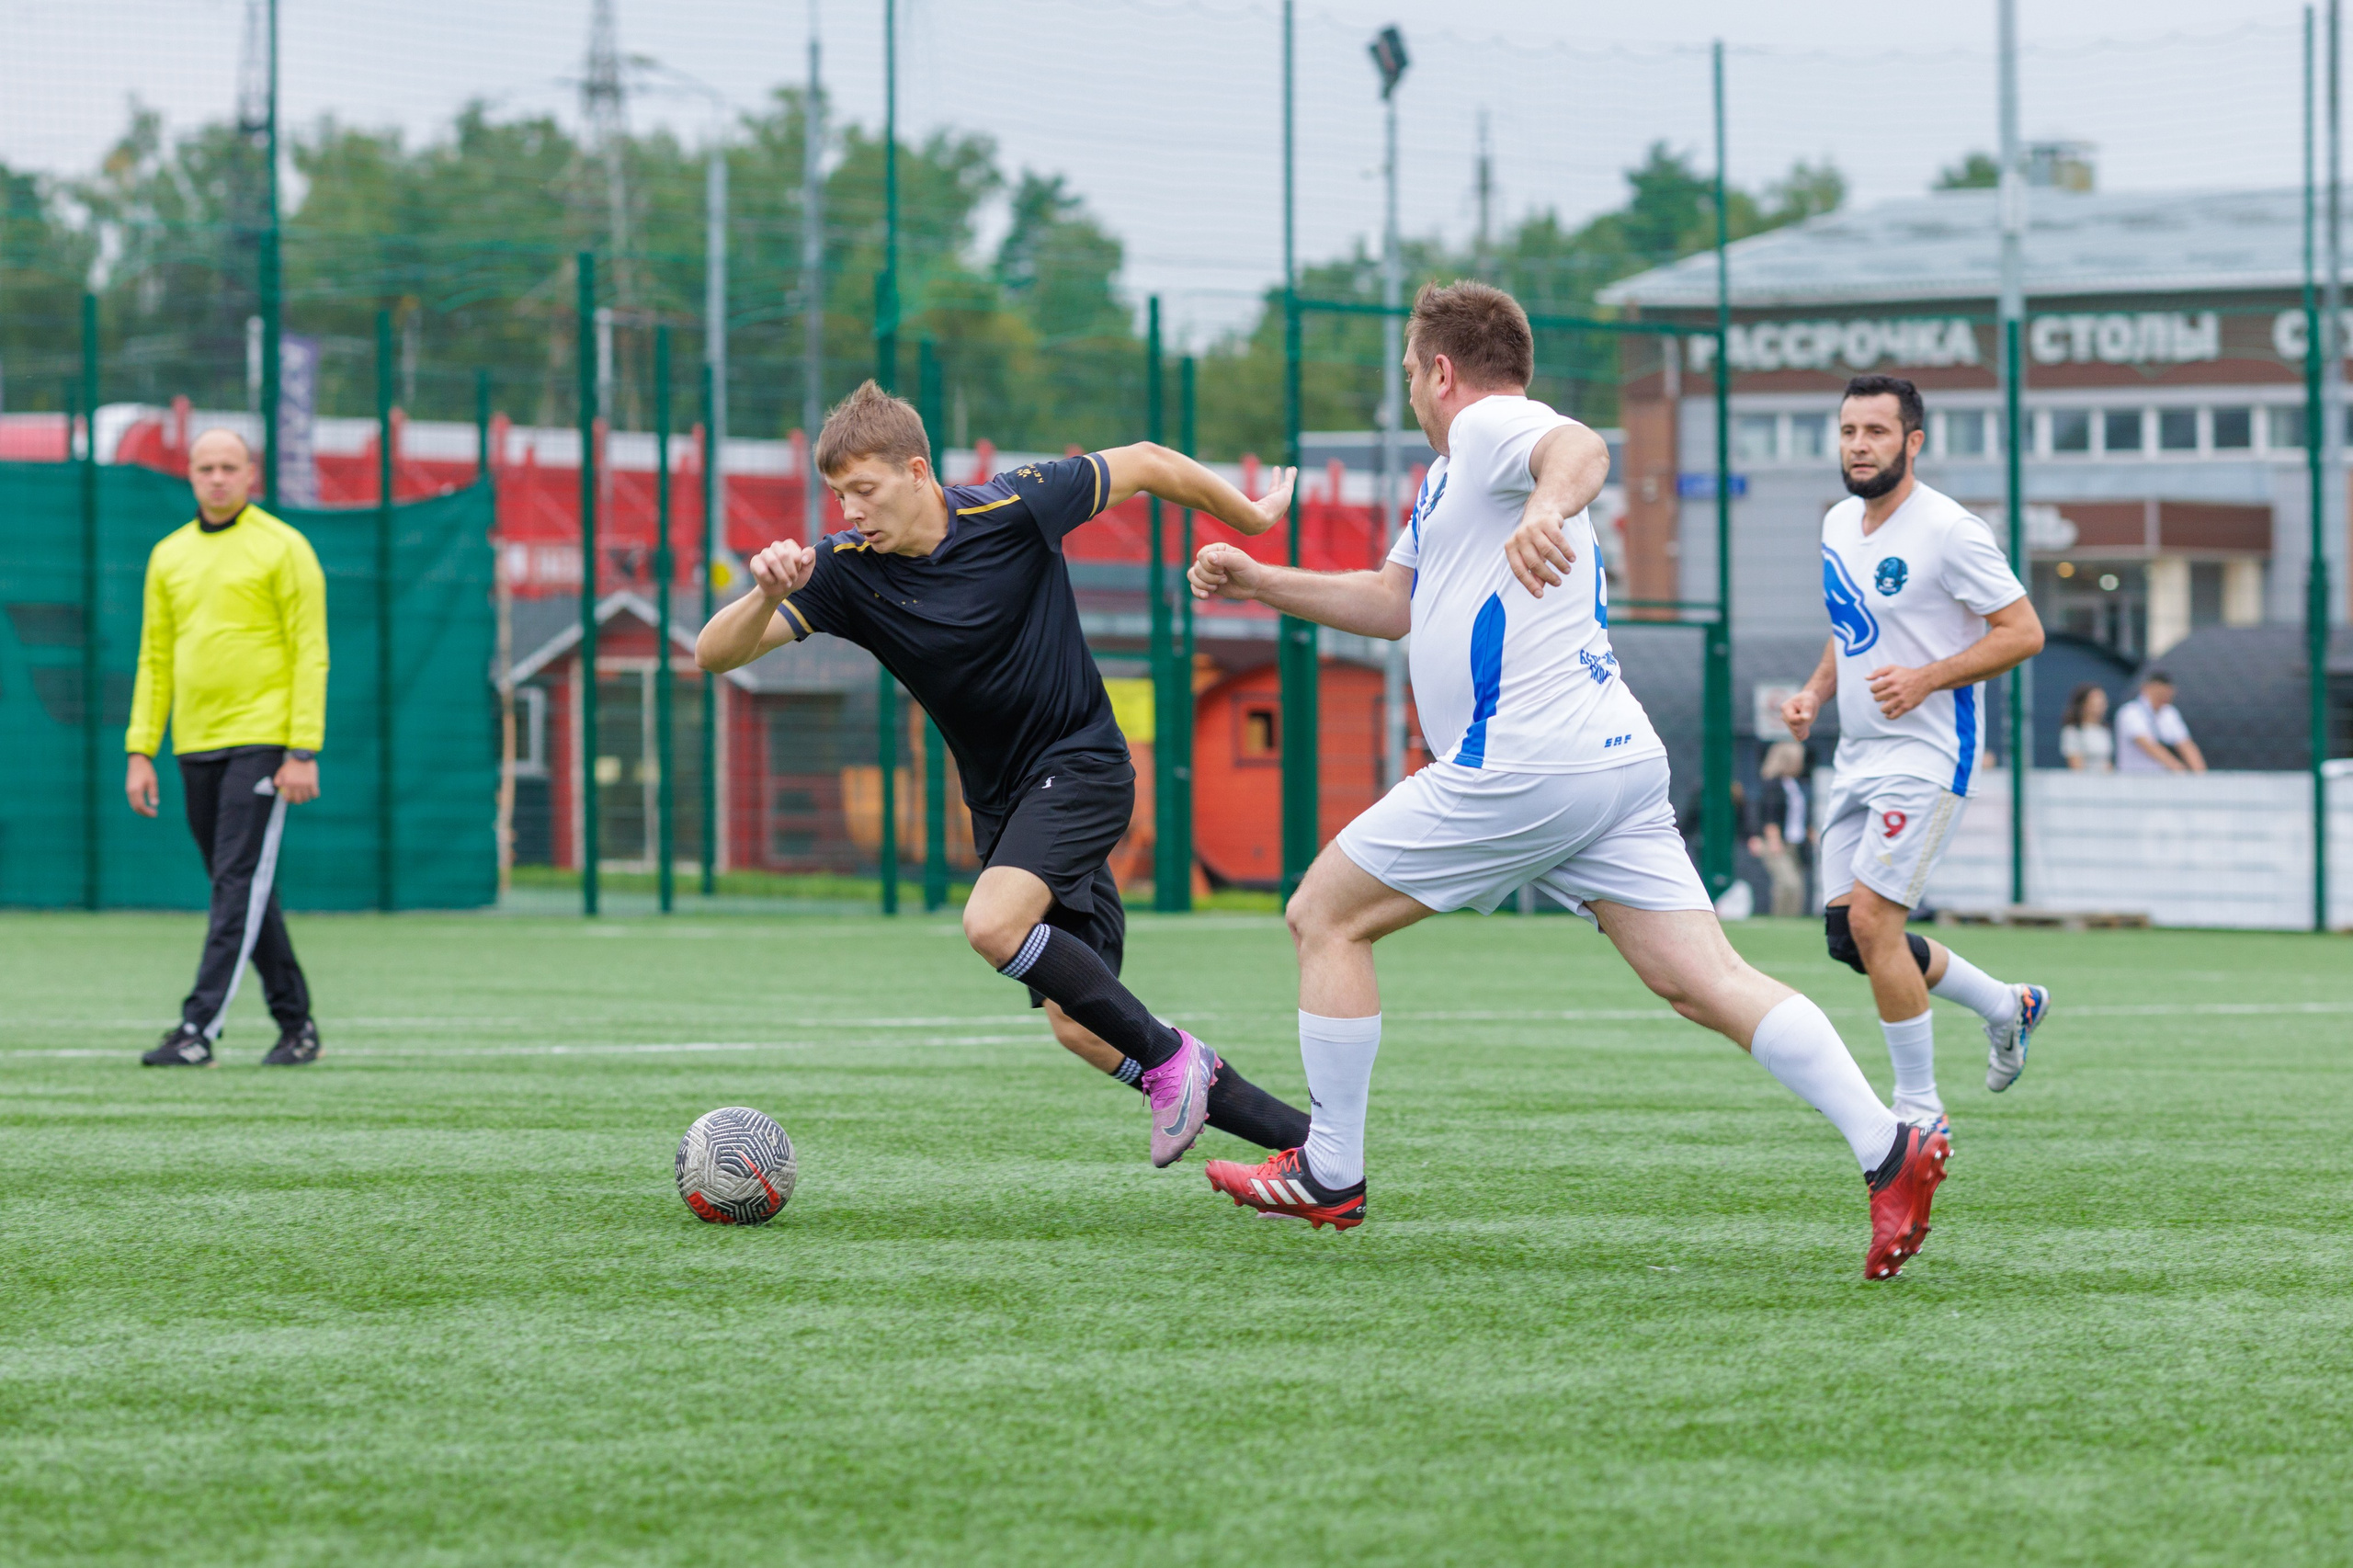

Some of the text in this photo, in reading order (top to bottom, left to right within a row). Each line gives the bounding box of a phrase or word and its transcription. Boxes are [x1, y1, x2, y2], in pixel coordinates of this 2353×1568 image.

[1688, 318, 1980, 370] РАССРОЧКА
[2029, 311, 2220, 364] СТОЛЫ
[1882, 810, 1907, 838] 9
